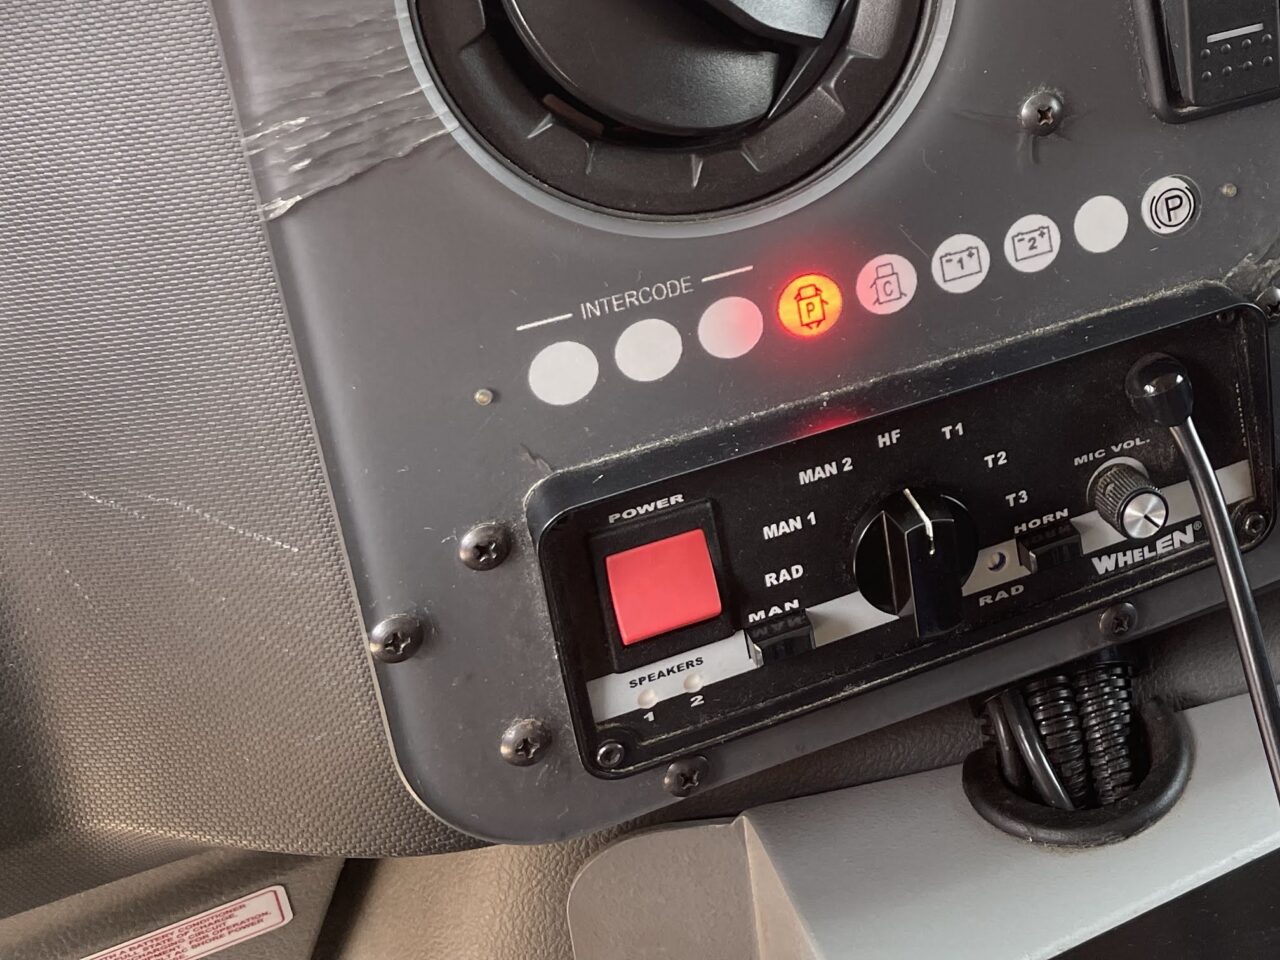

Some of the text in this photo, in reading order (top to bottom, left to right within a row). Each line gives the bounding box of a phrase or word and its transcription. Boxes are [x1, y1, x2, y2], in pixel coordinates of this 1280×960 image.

[1165, 194, 1183, 222] P
[581, 276, 694, 319] INTERCODE
[883, 280, 893, 296] C
[805, 302, 815, 318] P
[877, 429, 901, 449] HF
[941, 422, 964, 440] T1
[984, 450, 1008, 469] T2
[1073, 436, 1150, 466] MIC VOL.
[798, 457, 853, 485] MAN 2
[608, 493, 685, 524] POWER
[1005, 490, 1029, 507] T3
[762, 512, 817, 540] MAN 1
[1014, 508, 1069, 535] HORN
[764, 564, 804, 587] RAD
[978, 584, 1025, 607] RAD
[748, 599, 800, 622] MAN
[629, 656, 704, 688] SPEAKERS
[690, 695, 705, 707] 2
[643, 711, 655, 722] 1
